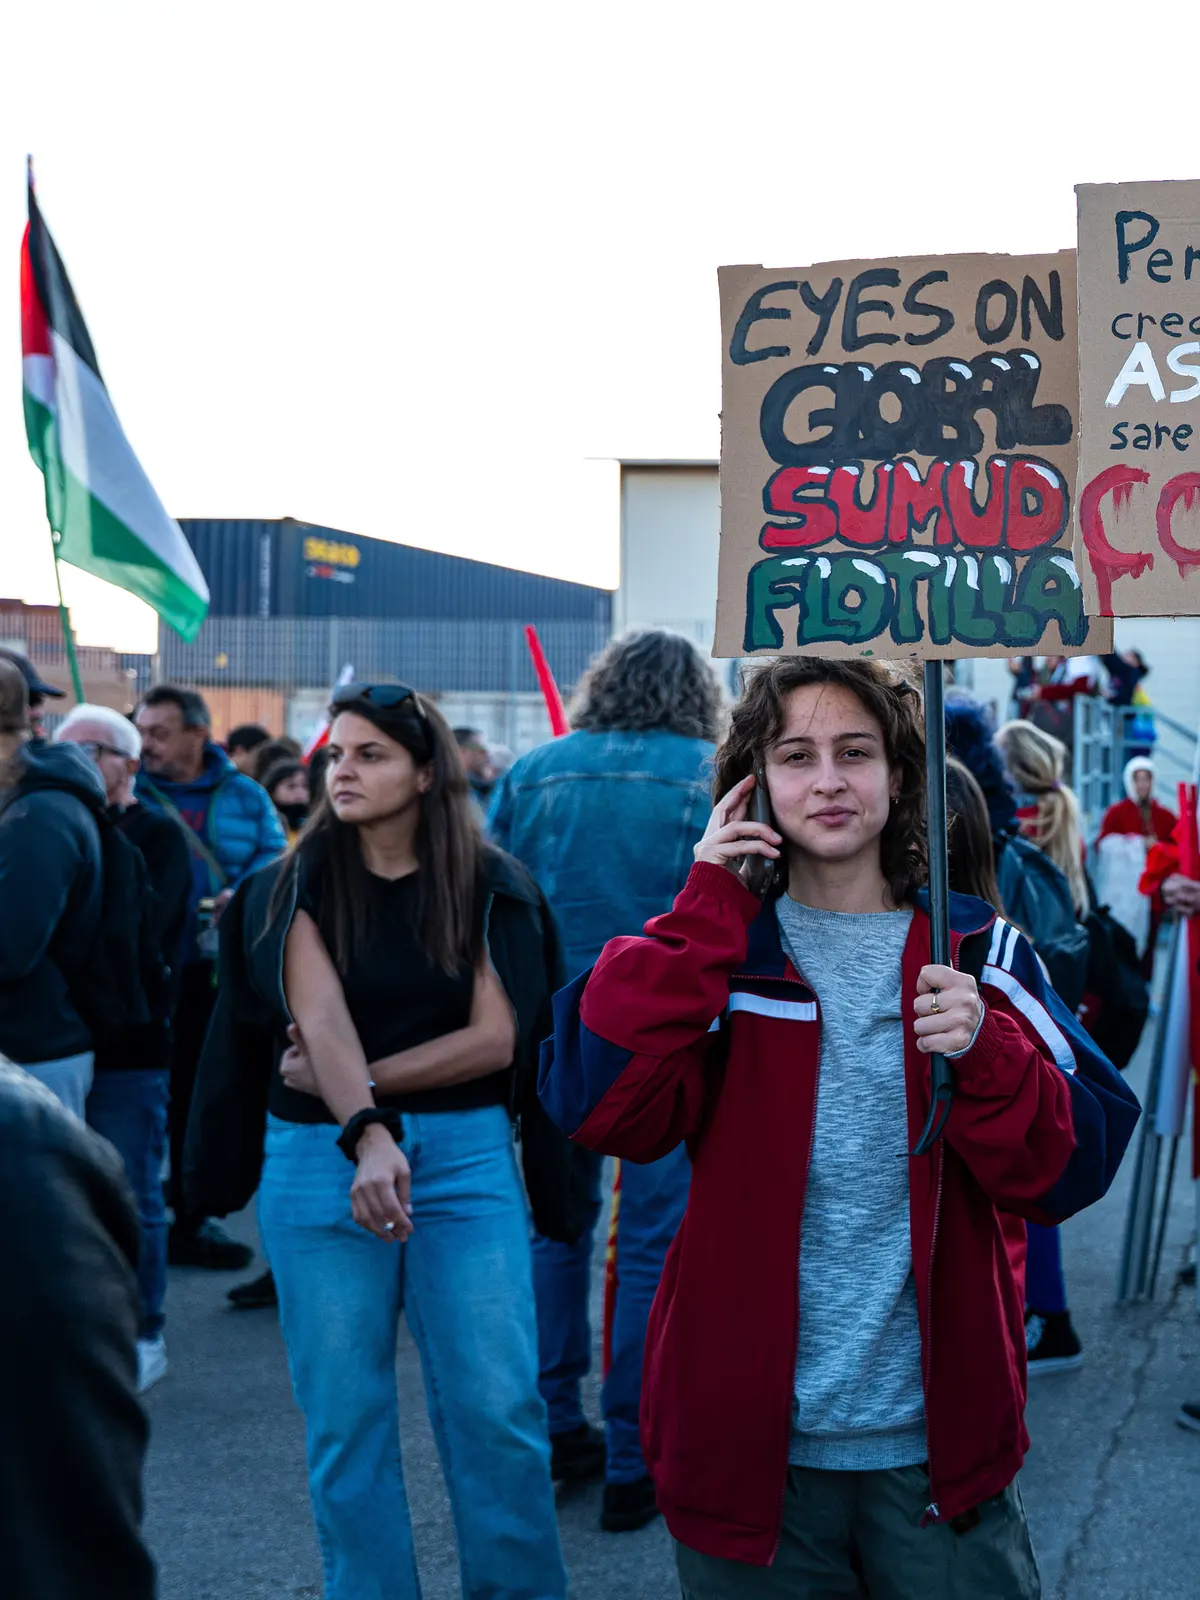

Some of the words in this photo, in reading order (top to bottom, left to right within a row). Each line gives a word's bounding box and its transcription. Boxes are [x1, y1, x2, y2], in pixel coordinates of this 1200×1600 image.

[730, 268, 954, 366] EYES
[975, 270, 1065, 346] ON
[760, 348, 1073, 466] GLOBAL
[759, 453, 1071, 553] SUMUD
[743, 547, 1090, 652] FLOTILLA
